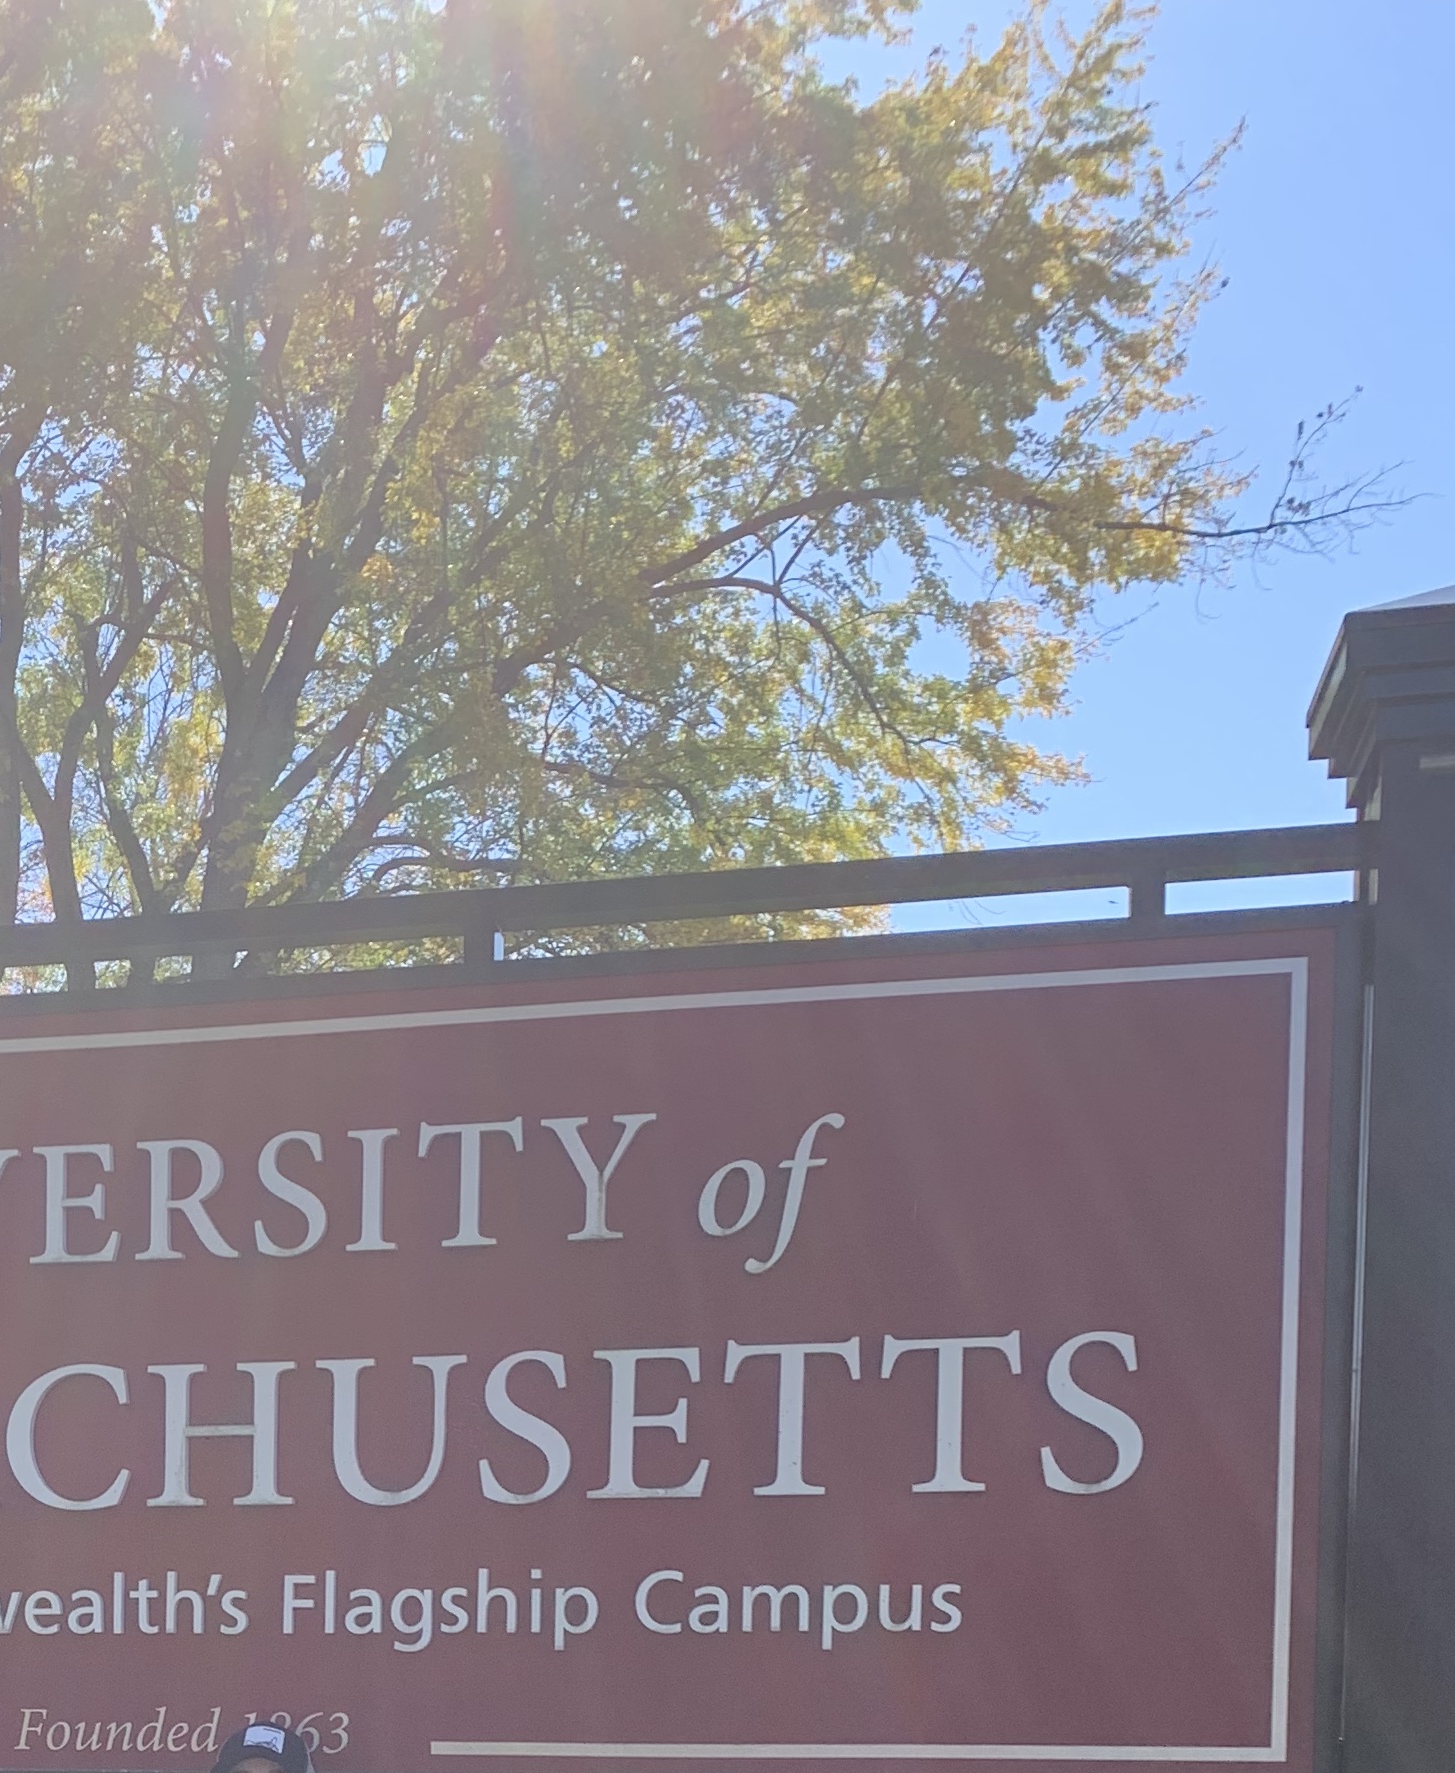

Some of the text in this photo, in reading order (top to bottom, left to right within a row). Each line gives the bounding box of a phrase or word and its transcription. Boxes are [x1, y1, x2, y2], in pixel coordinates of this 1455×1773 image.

[696, 1111, 847, 1275] of
[281, 1567, 600, 1654] Flagship
[634, 1568, 964, 1652] Campus
[13, 1706, 222, 1754] Founded
